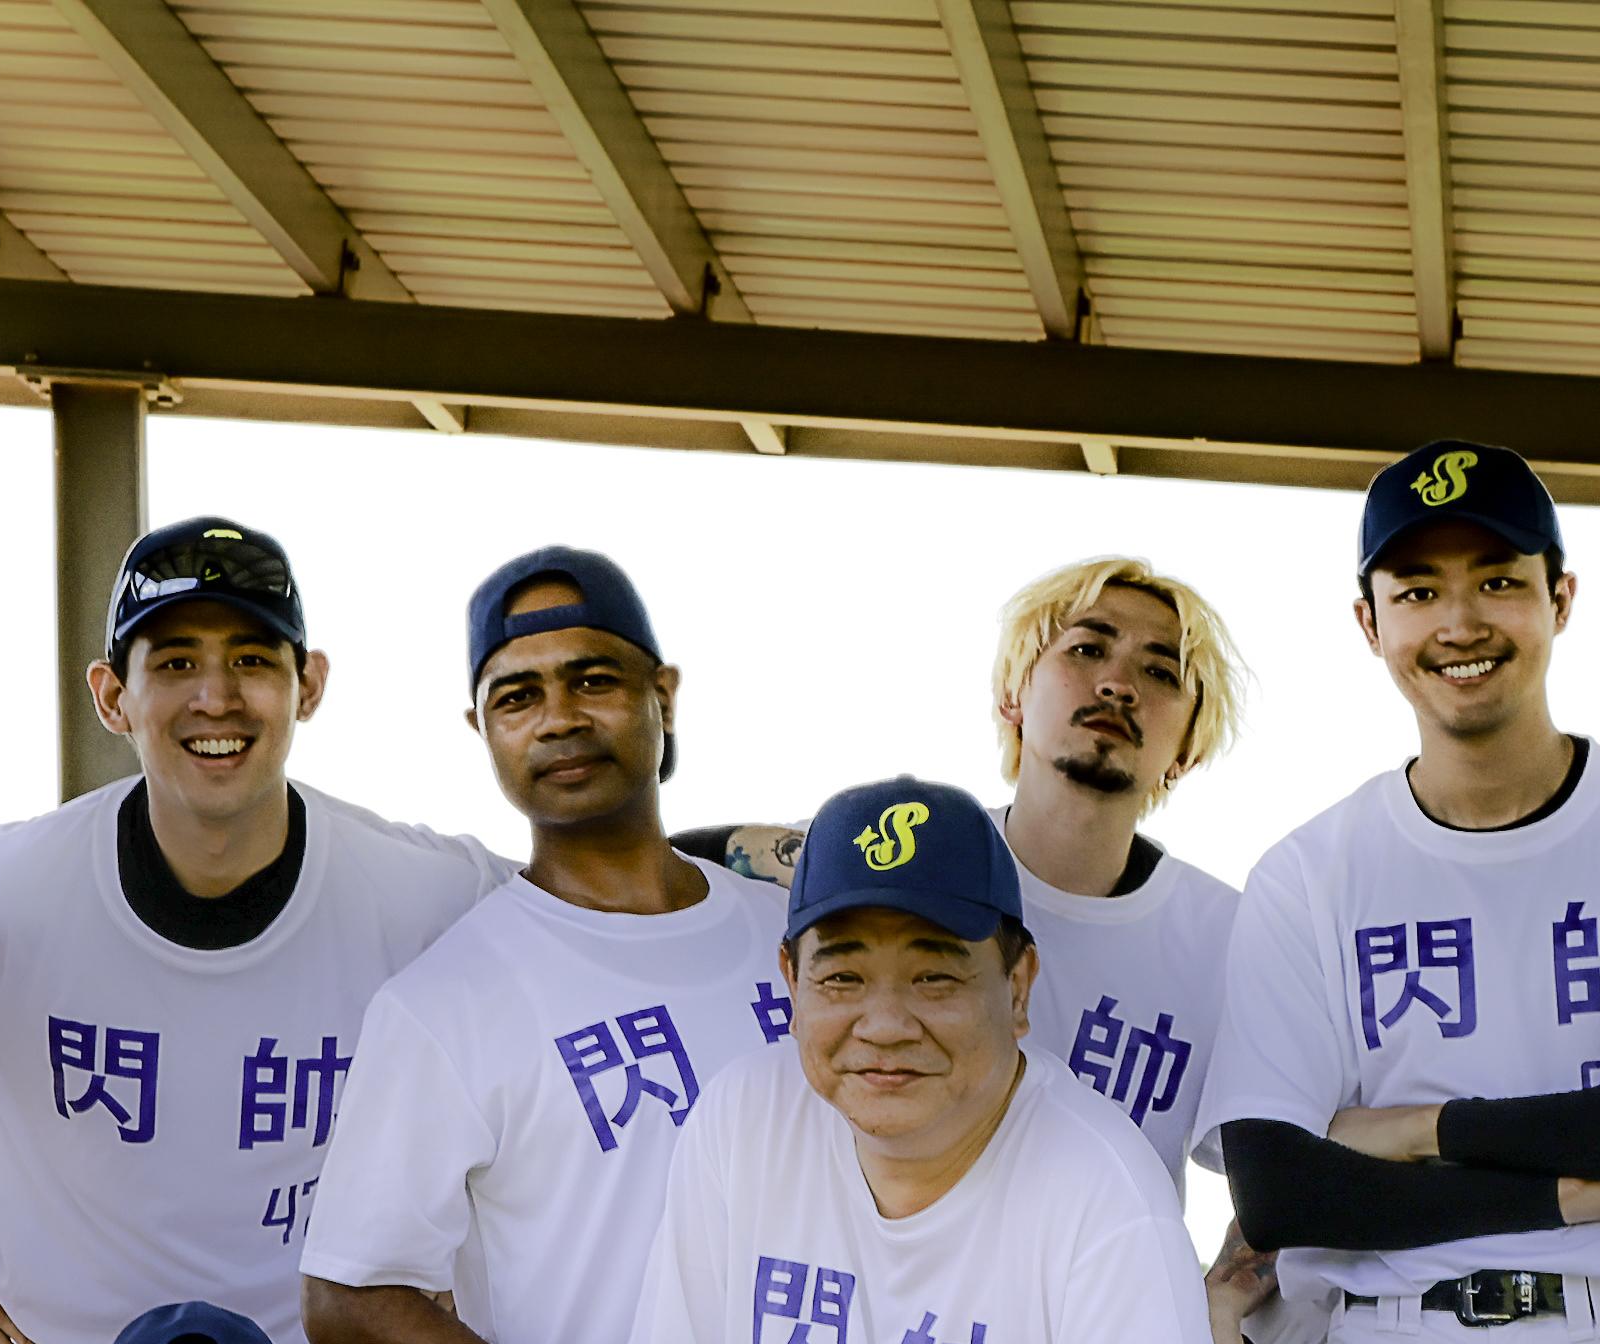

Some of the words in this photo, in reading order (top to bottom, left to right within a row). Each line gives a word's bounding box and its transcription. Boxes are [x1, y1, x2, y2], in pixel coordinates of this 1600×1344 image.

[1421, 450, 1480, 506] S
[865, 801, 930, 871] S
[1069, 995, 1193, 1129] 帥
